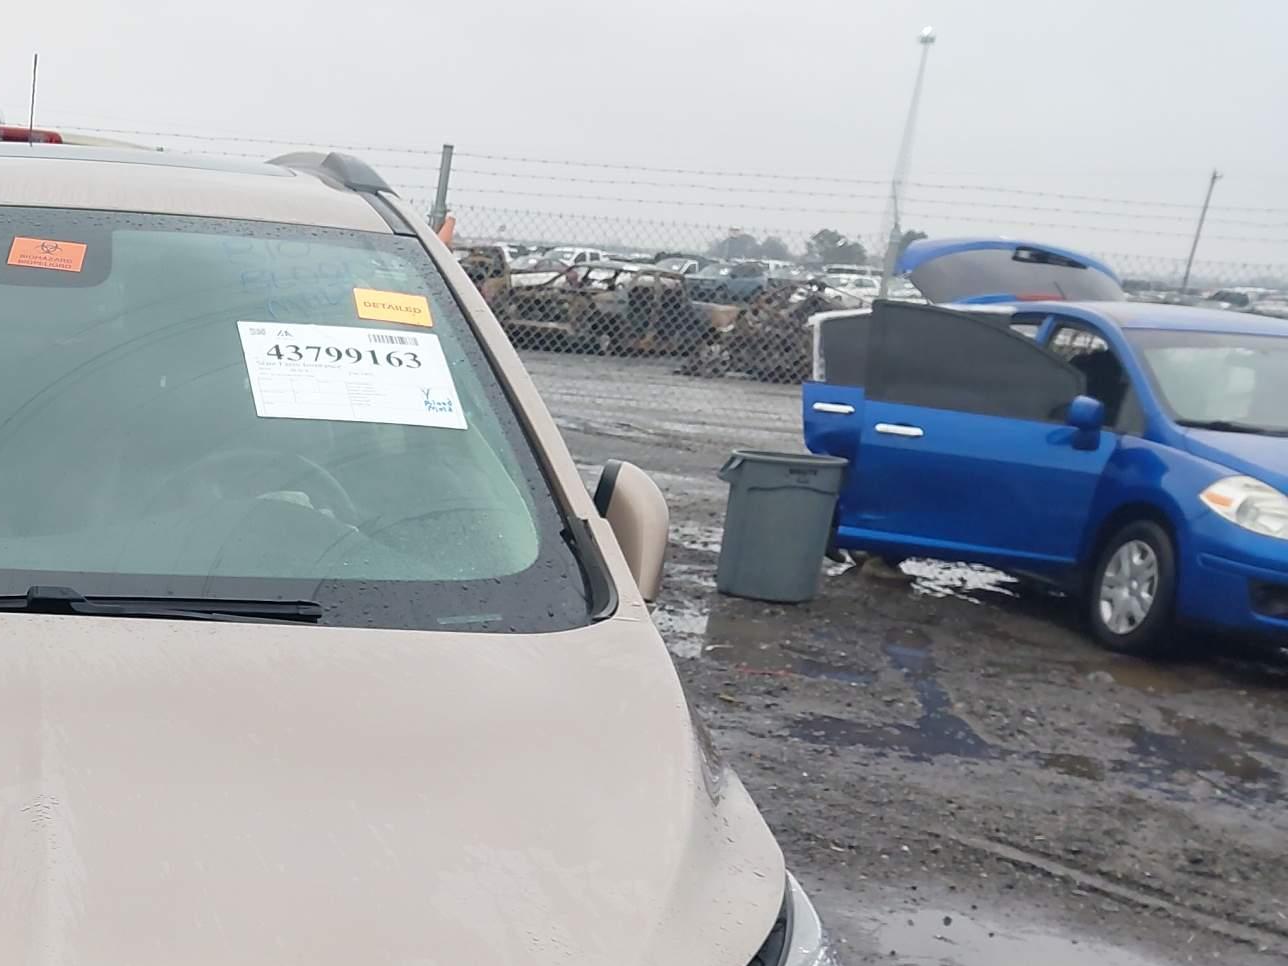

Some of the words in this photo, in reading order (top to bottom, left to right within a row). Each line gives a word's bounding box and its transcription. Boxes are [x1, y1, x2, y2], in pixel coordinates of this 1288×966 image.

[19, 254, 73, 264] BIOHAZARD
[363, 301, 422, 314] DETAILED
[266, 343, 422, 369] 43799163
